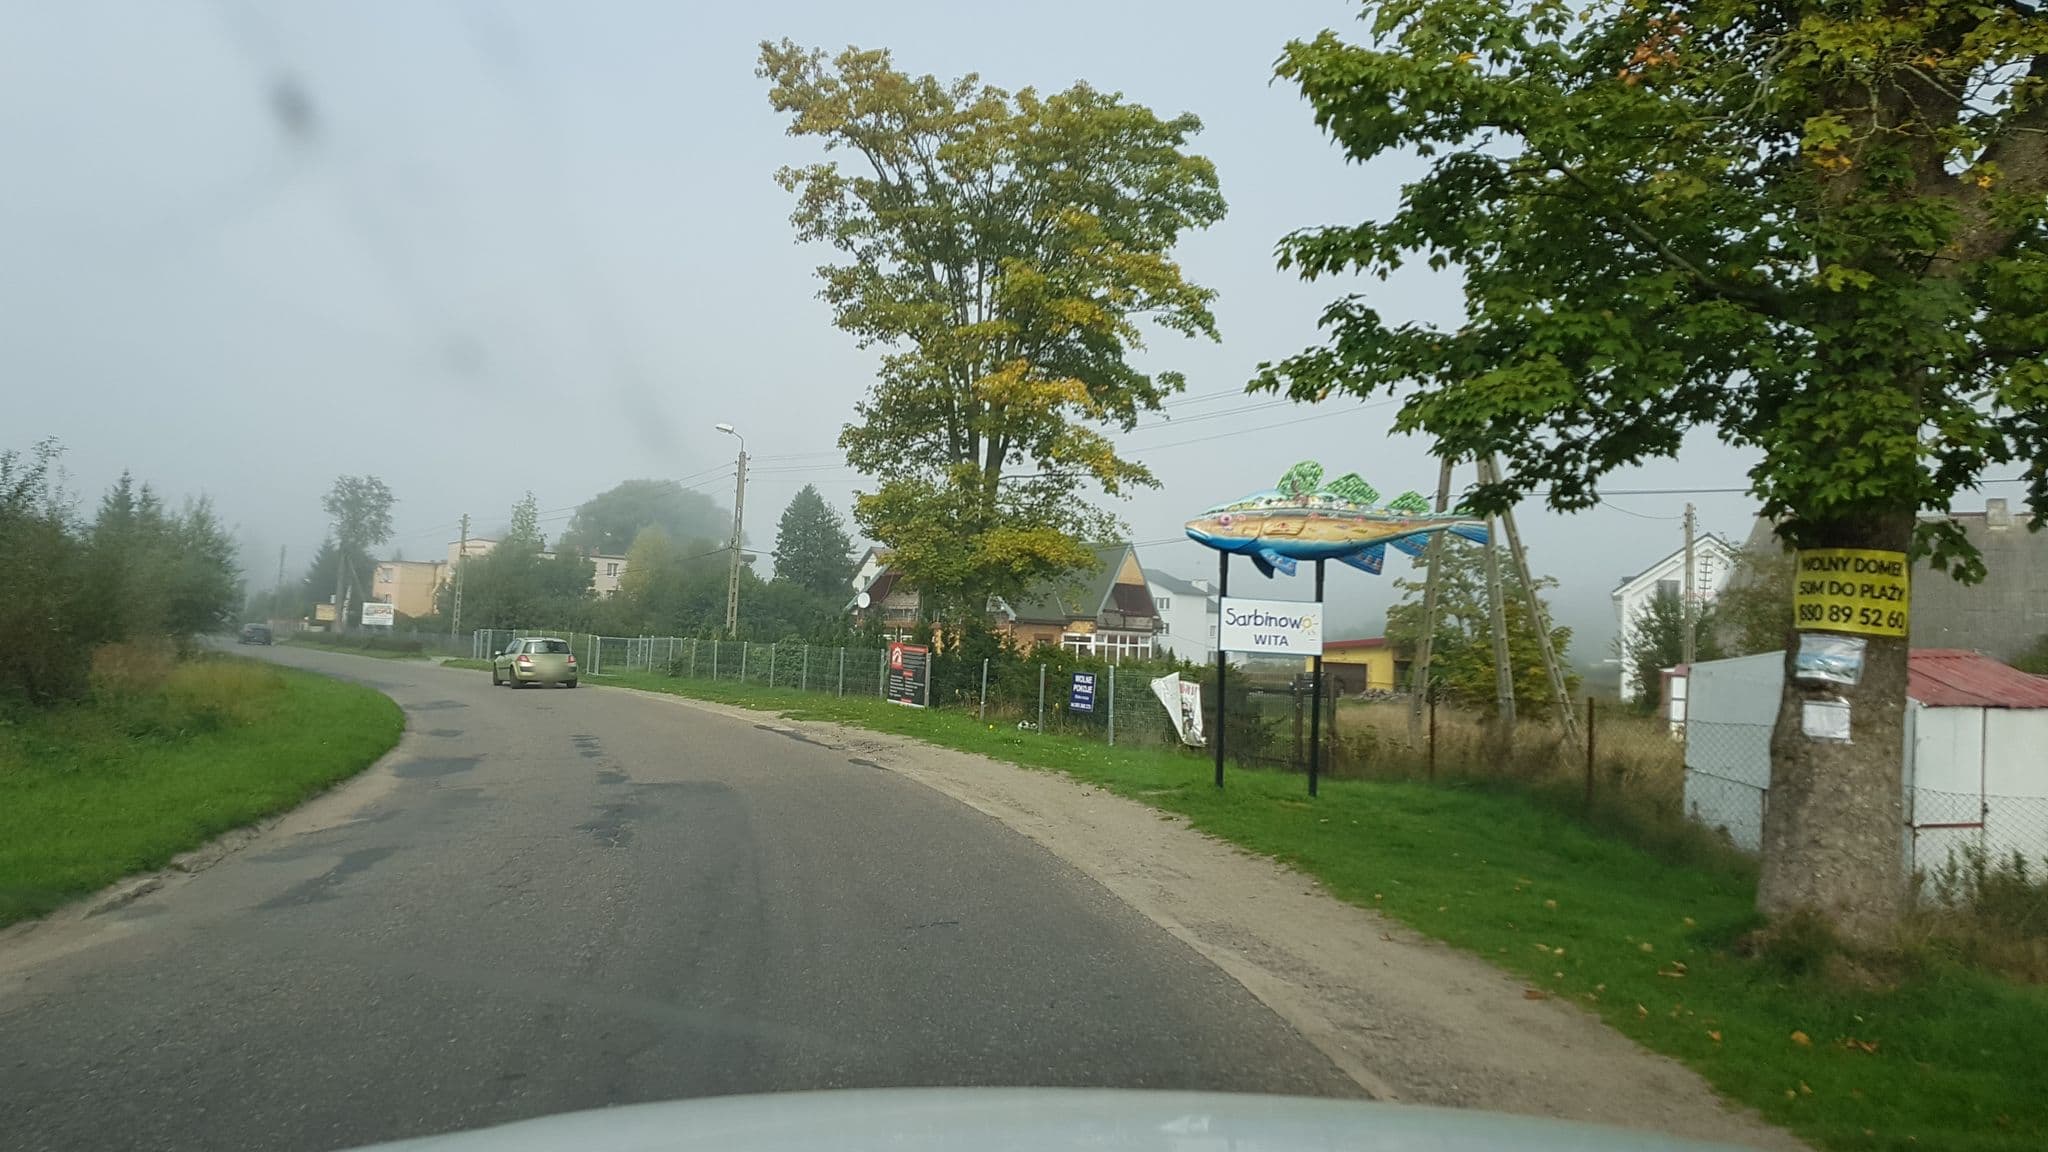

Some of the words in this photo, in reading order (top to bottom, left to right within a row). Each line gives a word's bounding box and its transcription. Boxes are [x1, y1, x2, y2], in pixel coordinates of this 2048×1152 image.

[1802, 556, 1850, 572] WOLNY
[1829, 581, 1855, 597] DO
[1860, 583, 1905, 602] PLAŻY
[1225, 607, 1313, 630] Sarbinowo
[1829, 604, 1853, 623] 89
[1860, 607, 1883, 628] 52
[1254, 634, 1289, 646] WITA
